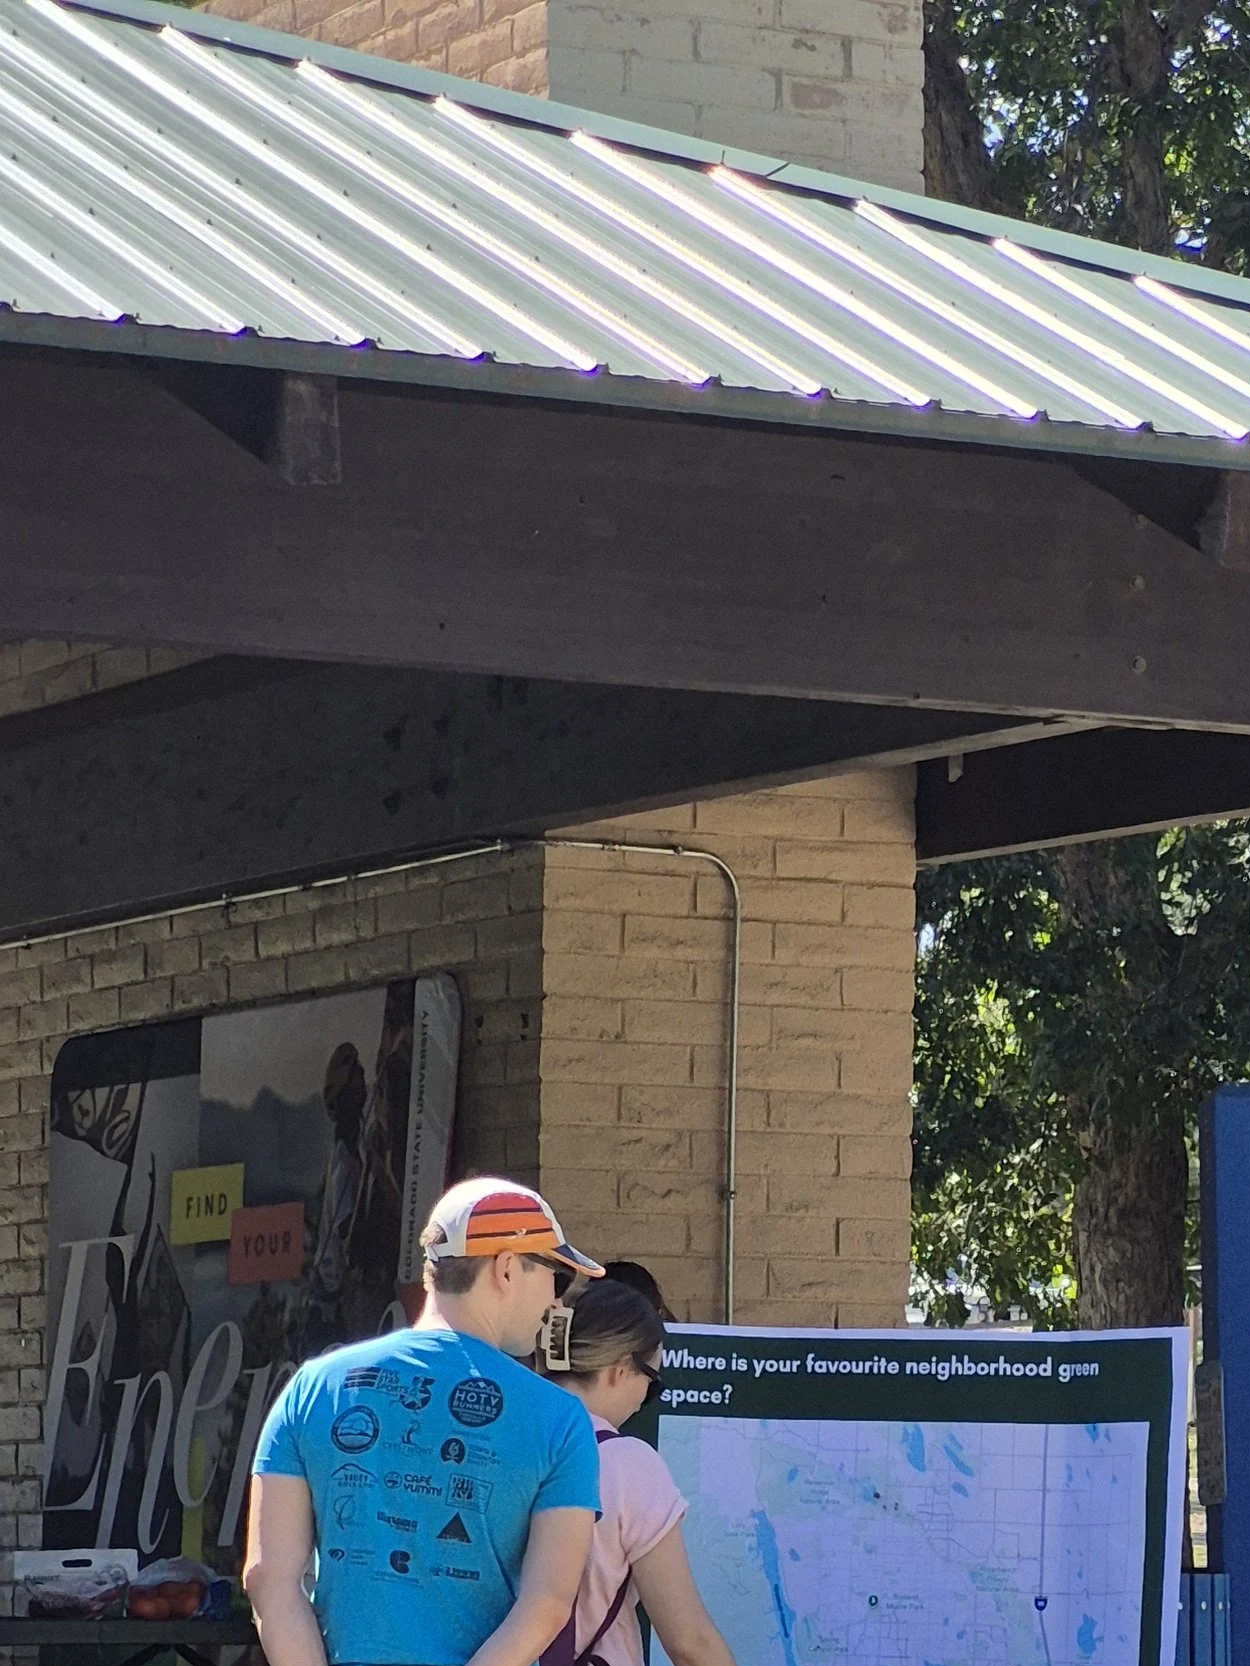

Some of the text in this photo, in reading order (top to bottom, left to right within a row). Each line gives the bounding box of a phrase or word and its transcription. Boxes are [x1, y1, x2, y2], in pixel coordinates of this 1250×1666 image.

[416, 1010, 430, 1117] UNIVERSITY
[410, 1119, 423, 1177] STATE
[185, 1193, 228, 1219] FIND
[243, 1230, 292, 1258] YOUR
[661, 1348, 1100, 1383] Where is your favourite neighborhood green
[660, 1384, 734, 1408] space?
